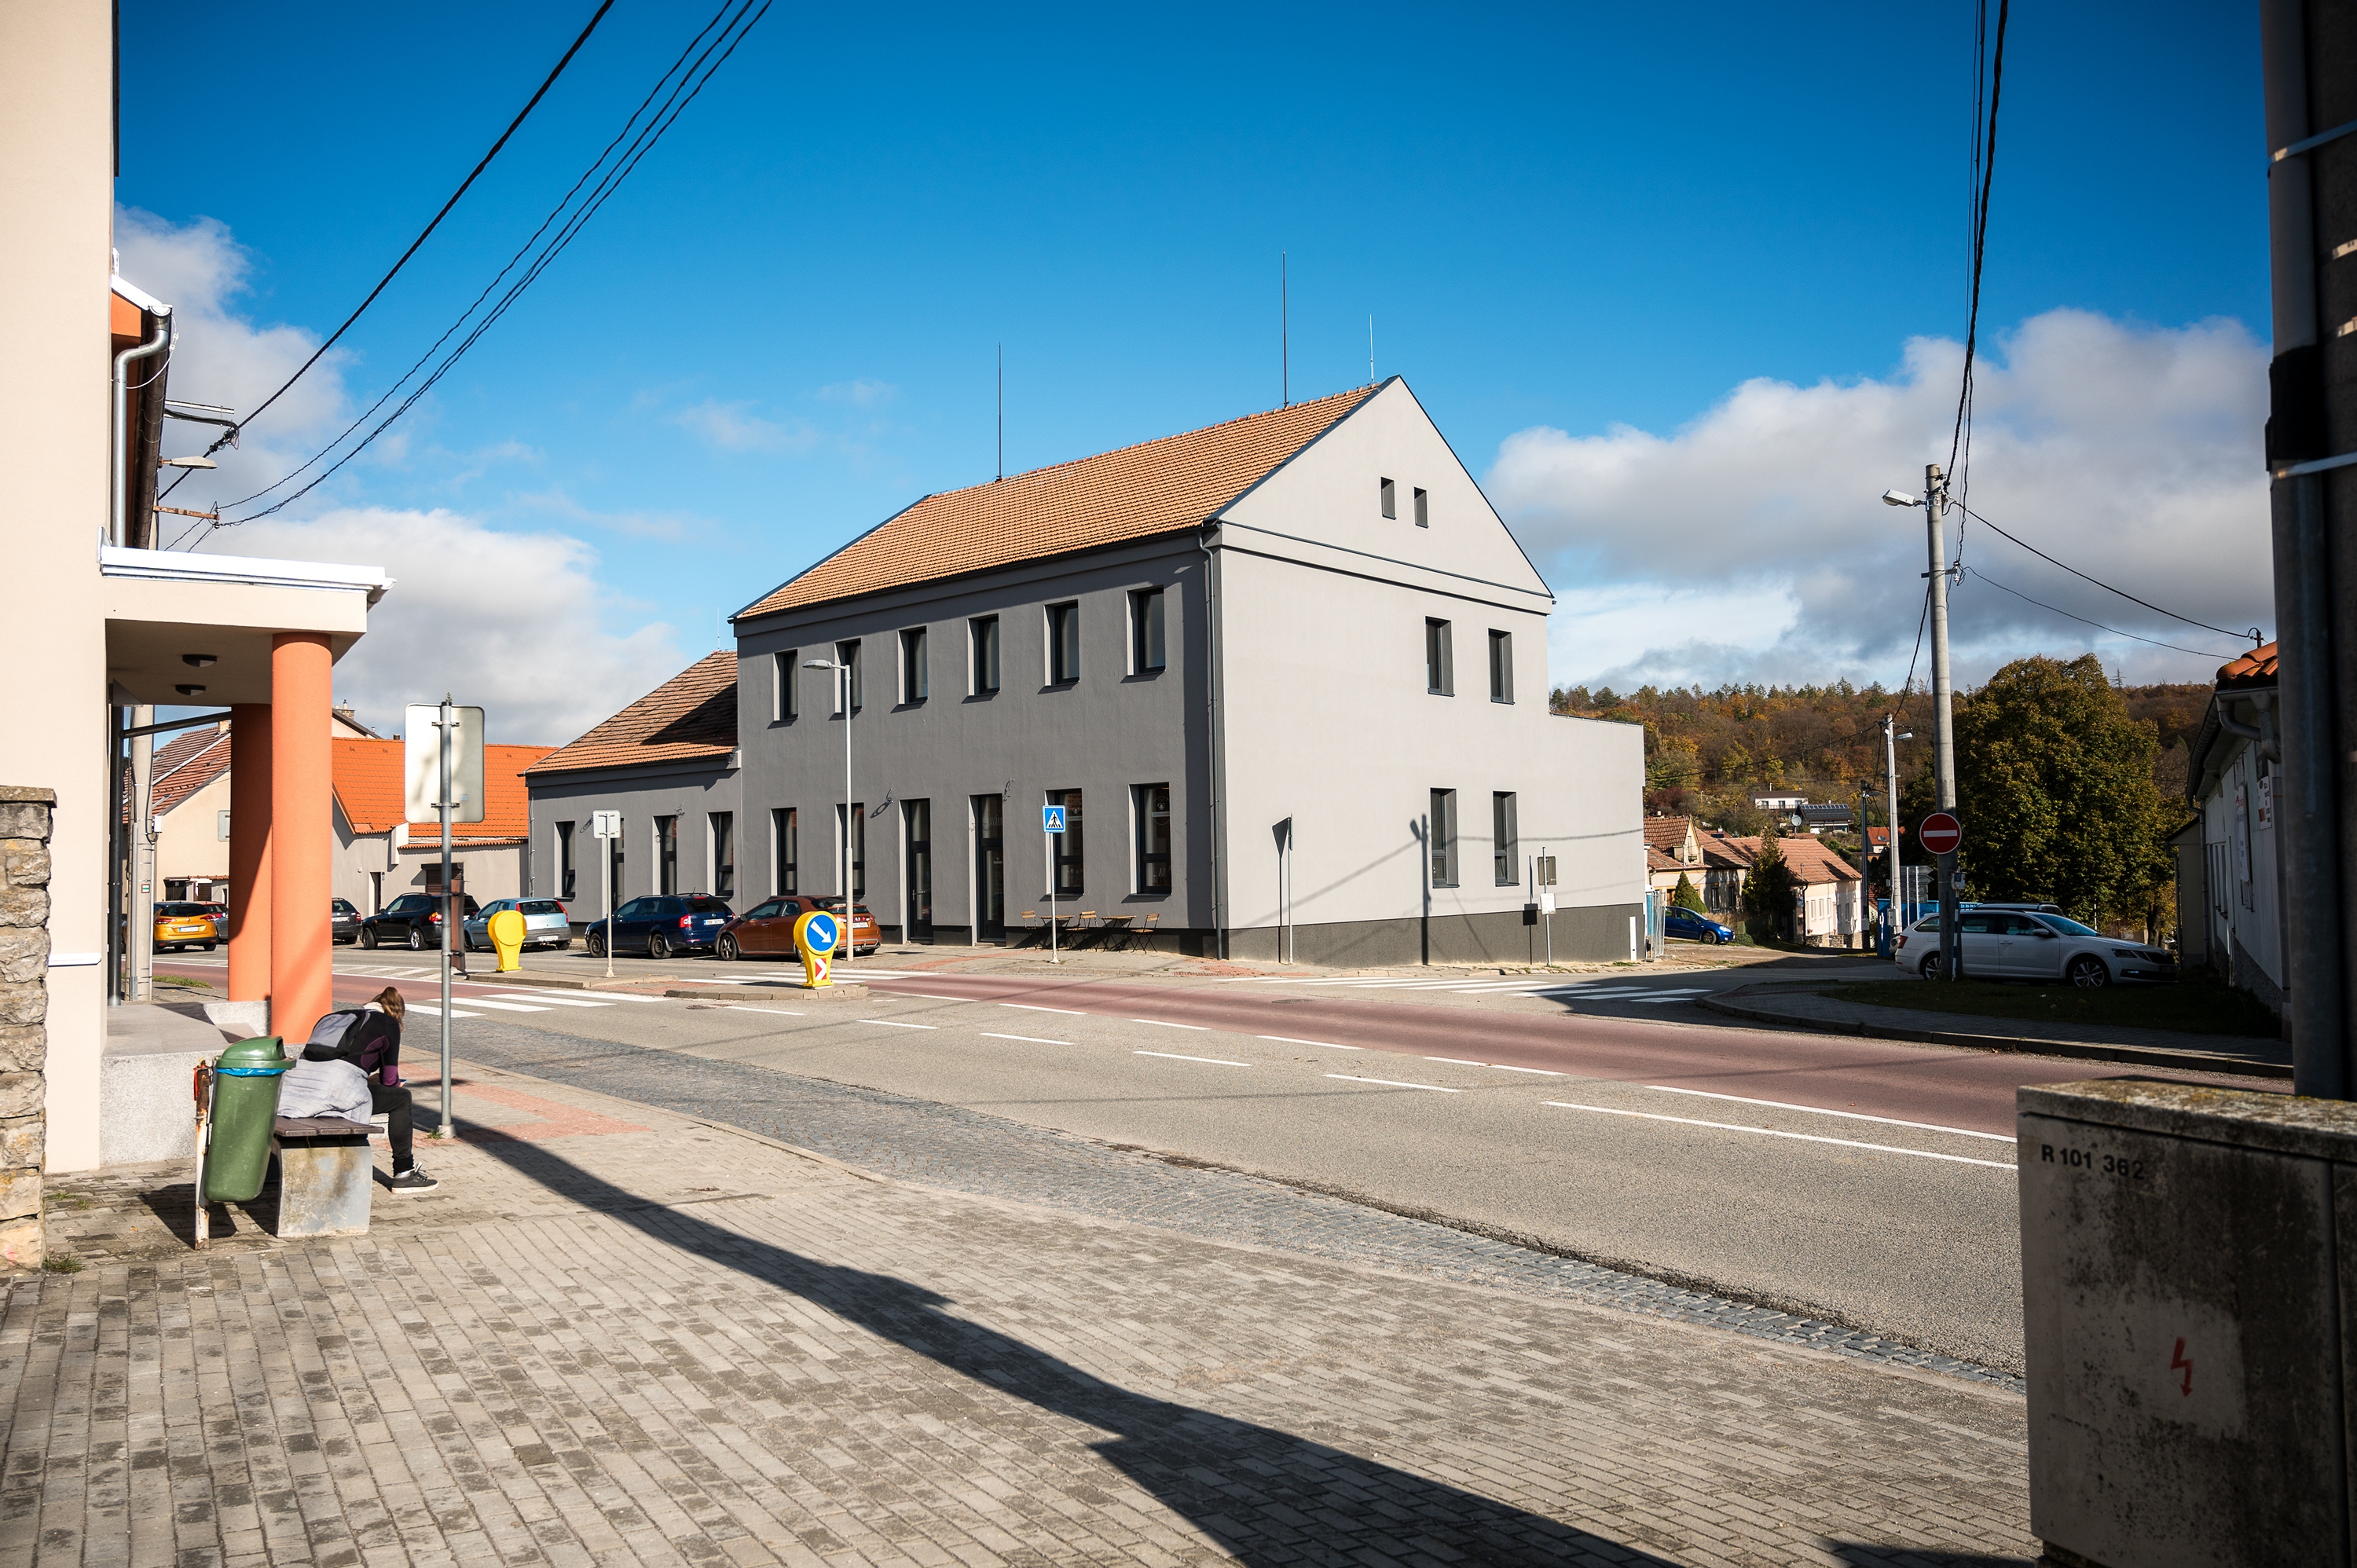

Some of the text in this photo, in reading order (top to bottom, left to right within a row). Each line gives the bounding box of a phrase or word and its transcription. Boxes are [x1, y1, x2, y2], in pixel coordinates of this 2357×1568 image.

[2041, 1144, 2144, 1179] R 101 362
